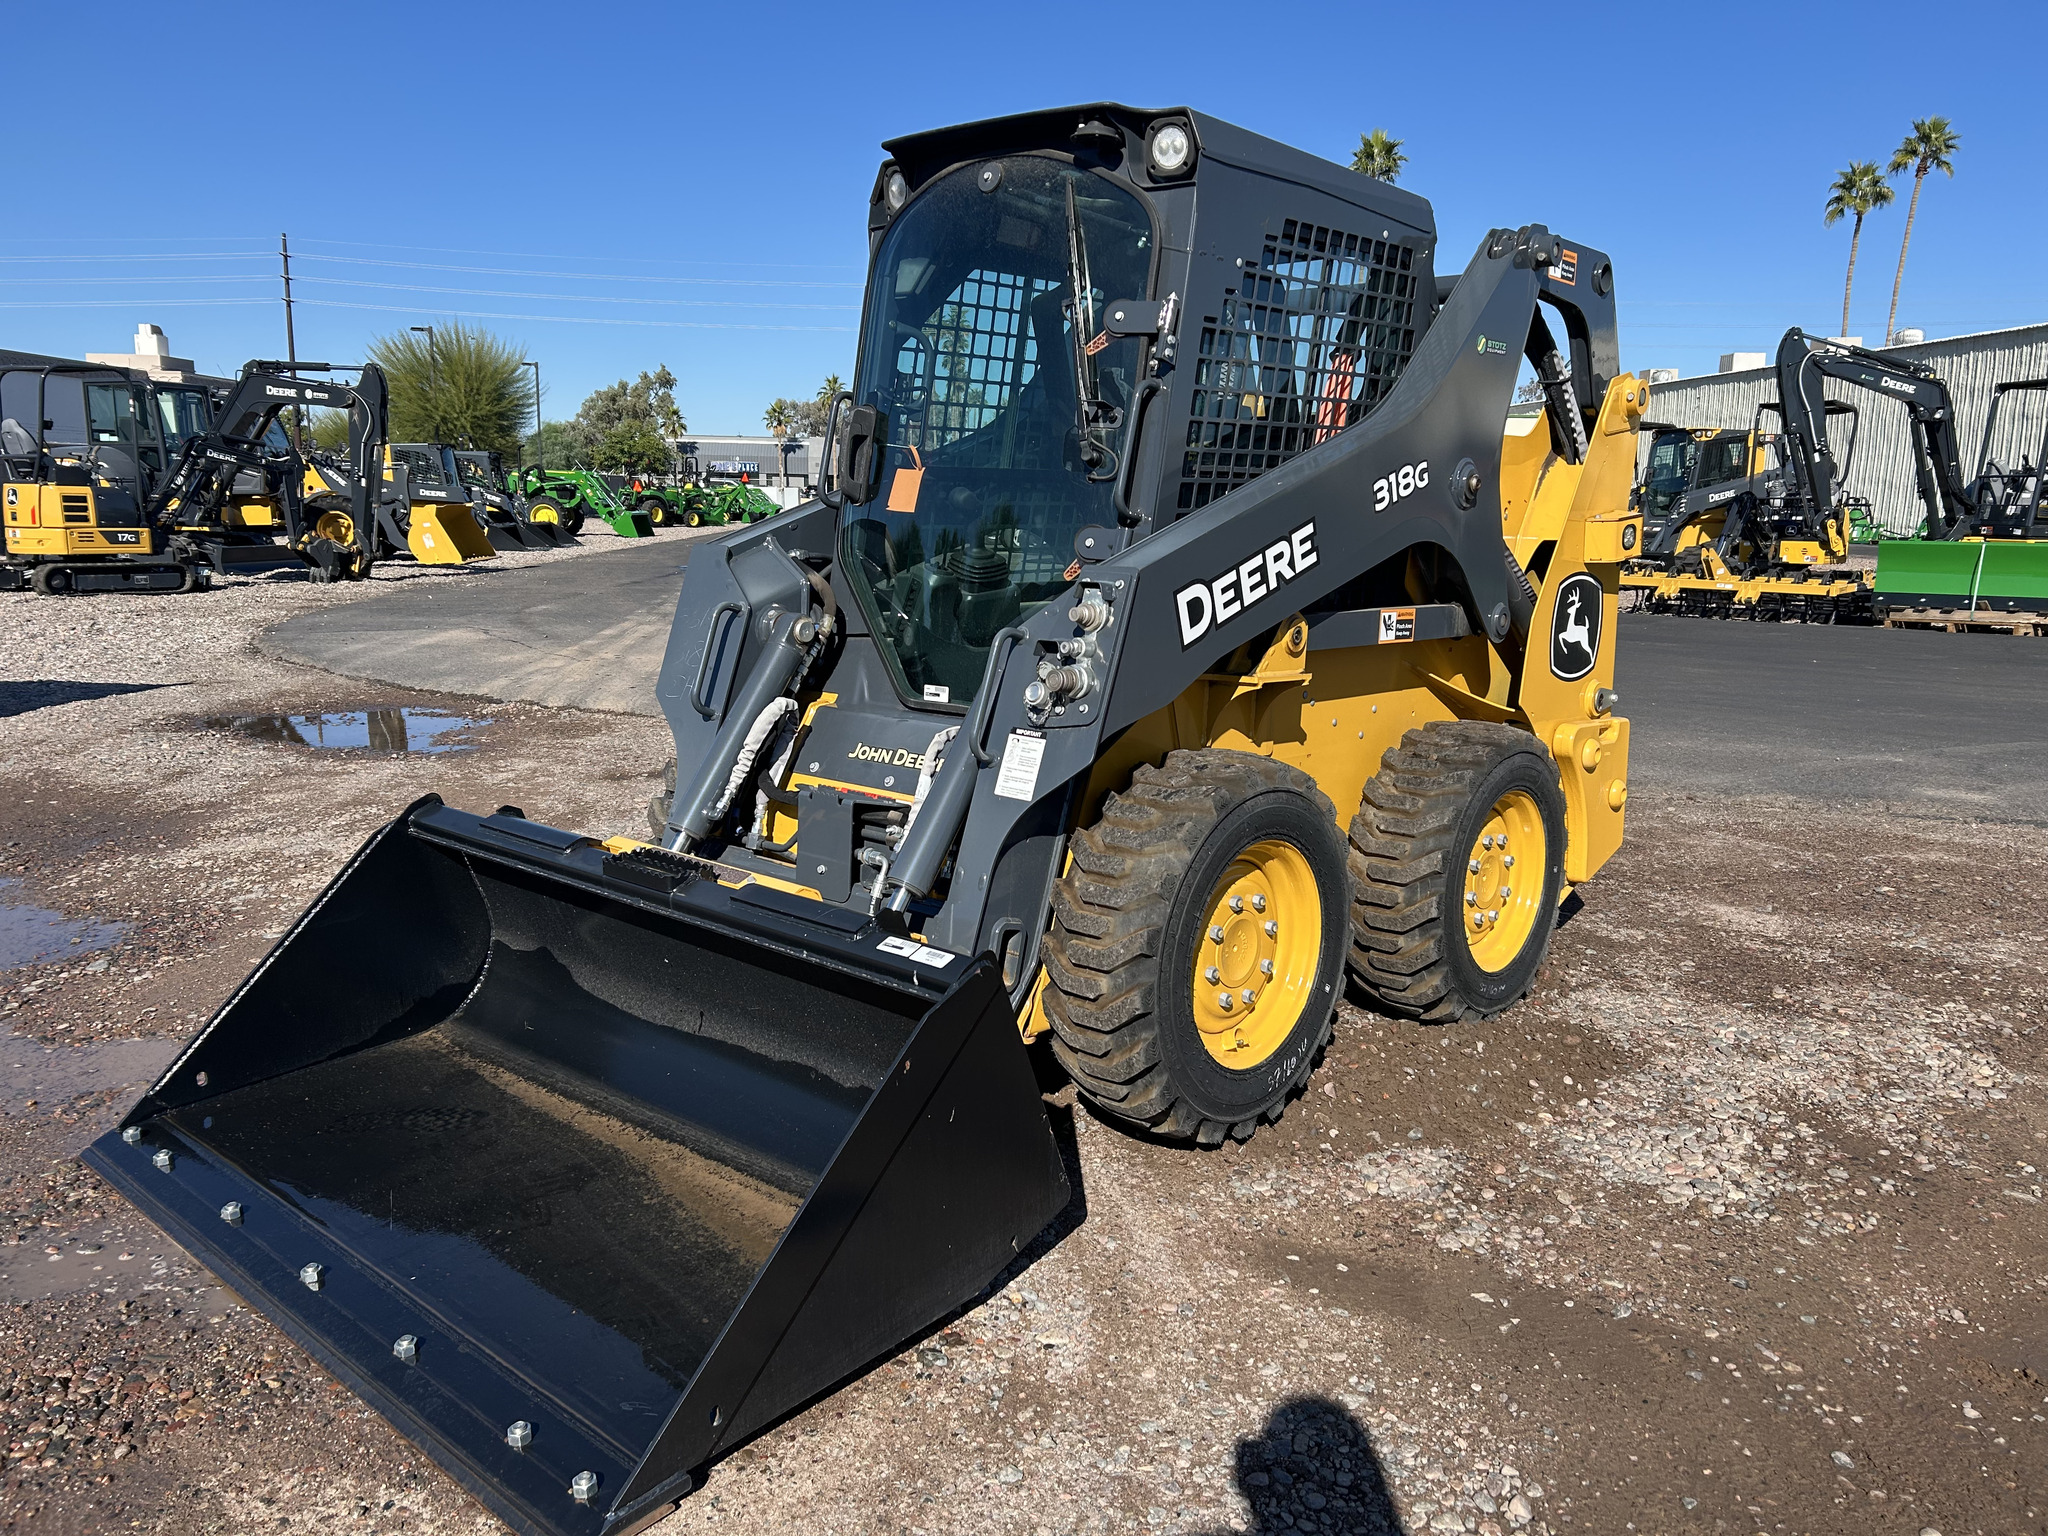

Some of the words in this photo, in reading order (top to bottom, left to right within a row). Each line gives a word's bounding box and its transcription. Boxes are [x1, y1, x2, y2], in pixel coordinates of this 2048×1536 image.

[1487, 340, 1507, 351] STOTZ
[265, 385, 298, 397] DEERE
[1880, 376, 1917, 394] DEERE
[206, 448, 238, 463] DEERE
[419, 488, 448, 498] DEERE
[1372, 460, 1430, 513] 318G
[1708, 489, 1736, 503] DEERE
[117, 533, 136, 542] 17G
[1176, 522, 1318, 646] DEERE
[1015, 728, 1043, 738] IMPORTANT
[847, 742, 893, 764] JOHN
